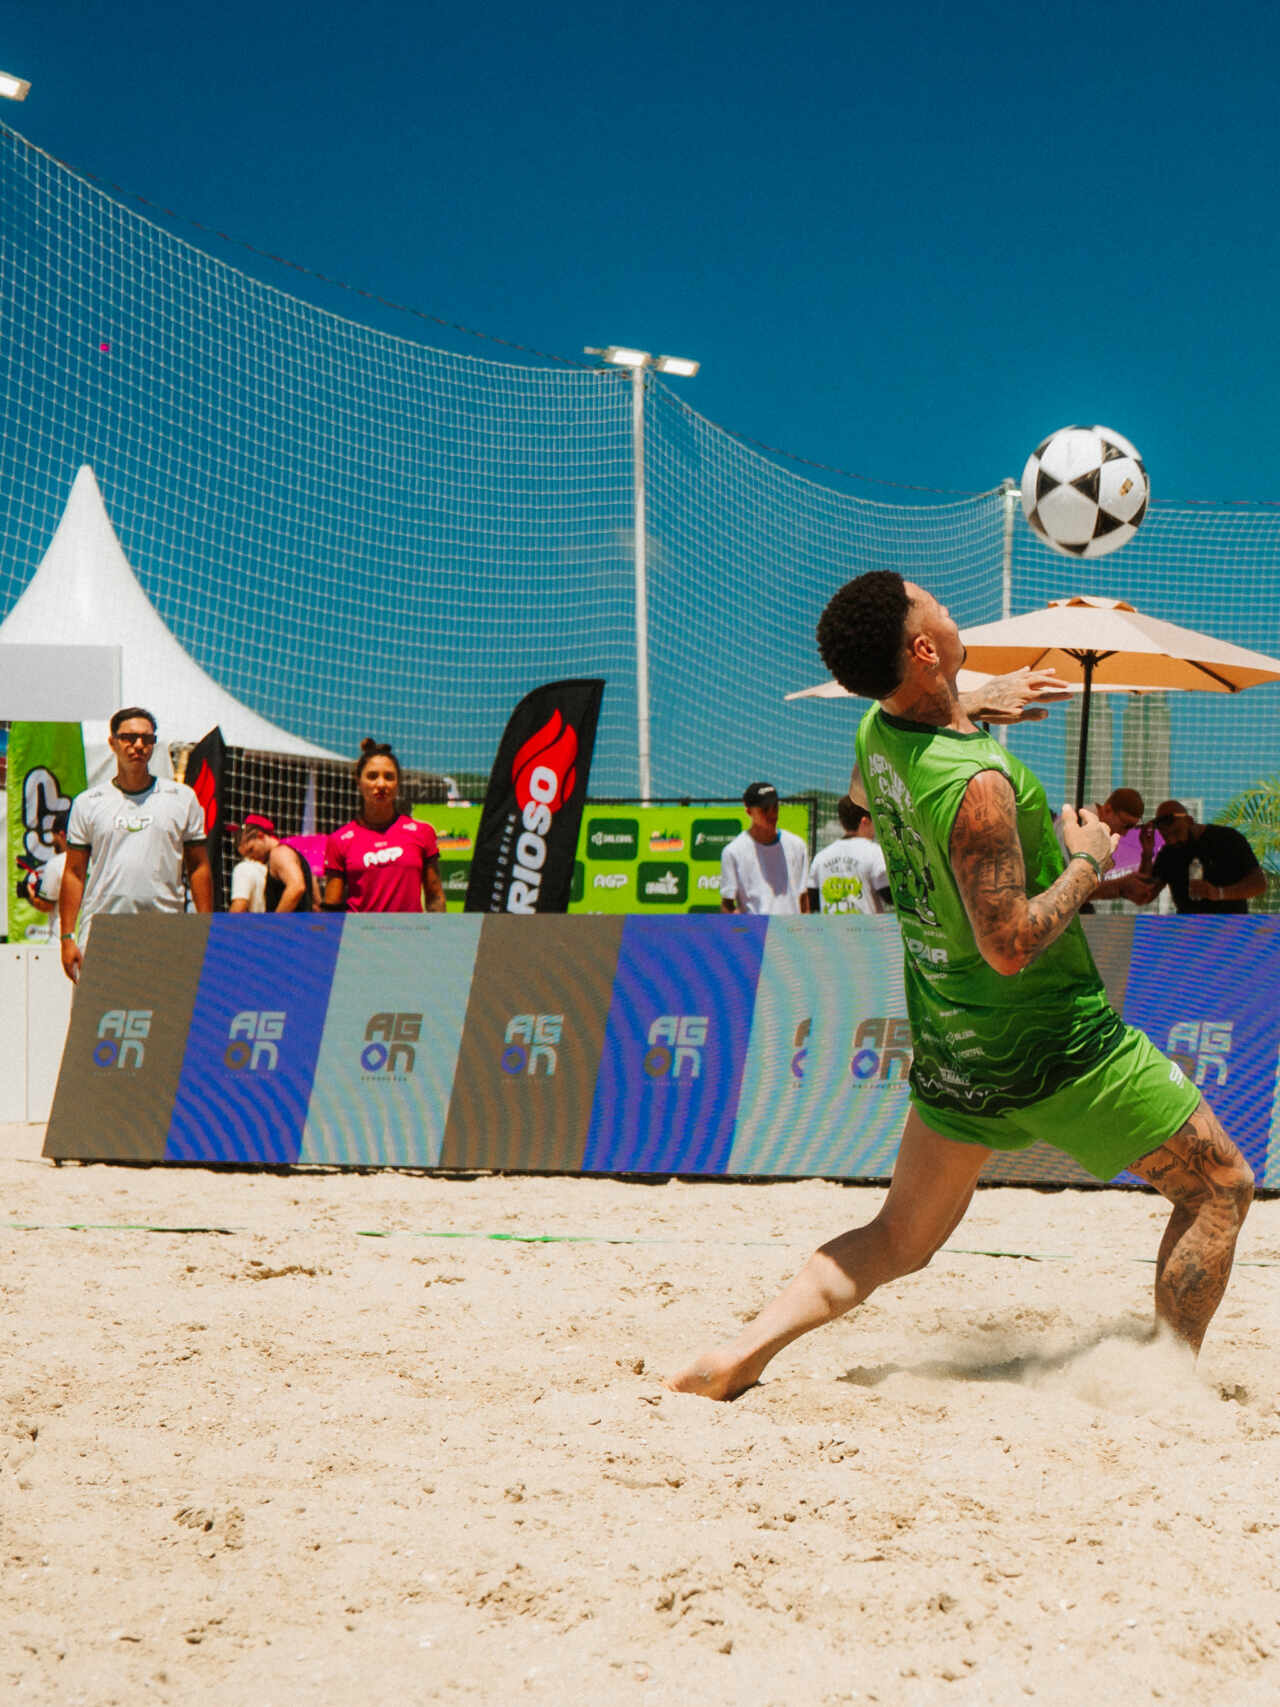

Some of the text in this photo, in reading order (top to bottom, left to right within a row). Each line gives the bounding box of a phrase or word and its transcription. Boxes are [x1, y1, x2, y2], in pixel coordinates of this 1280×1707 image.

[594, 874, 628, 889] AGP
[97, 1010, 153, 1038] AG
[229, 1012, 286, 1039] AG
[364, 1012, 423, 1041] AG
[504, 1015, 564, 1044] AG
[648, 1016, 708, 1045] AG
[854, 1018, 911, 1048] AG
[1167, 1022, 1233, 1053] AG
